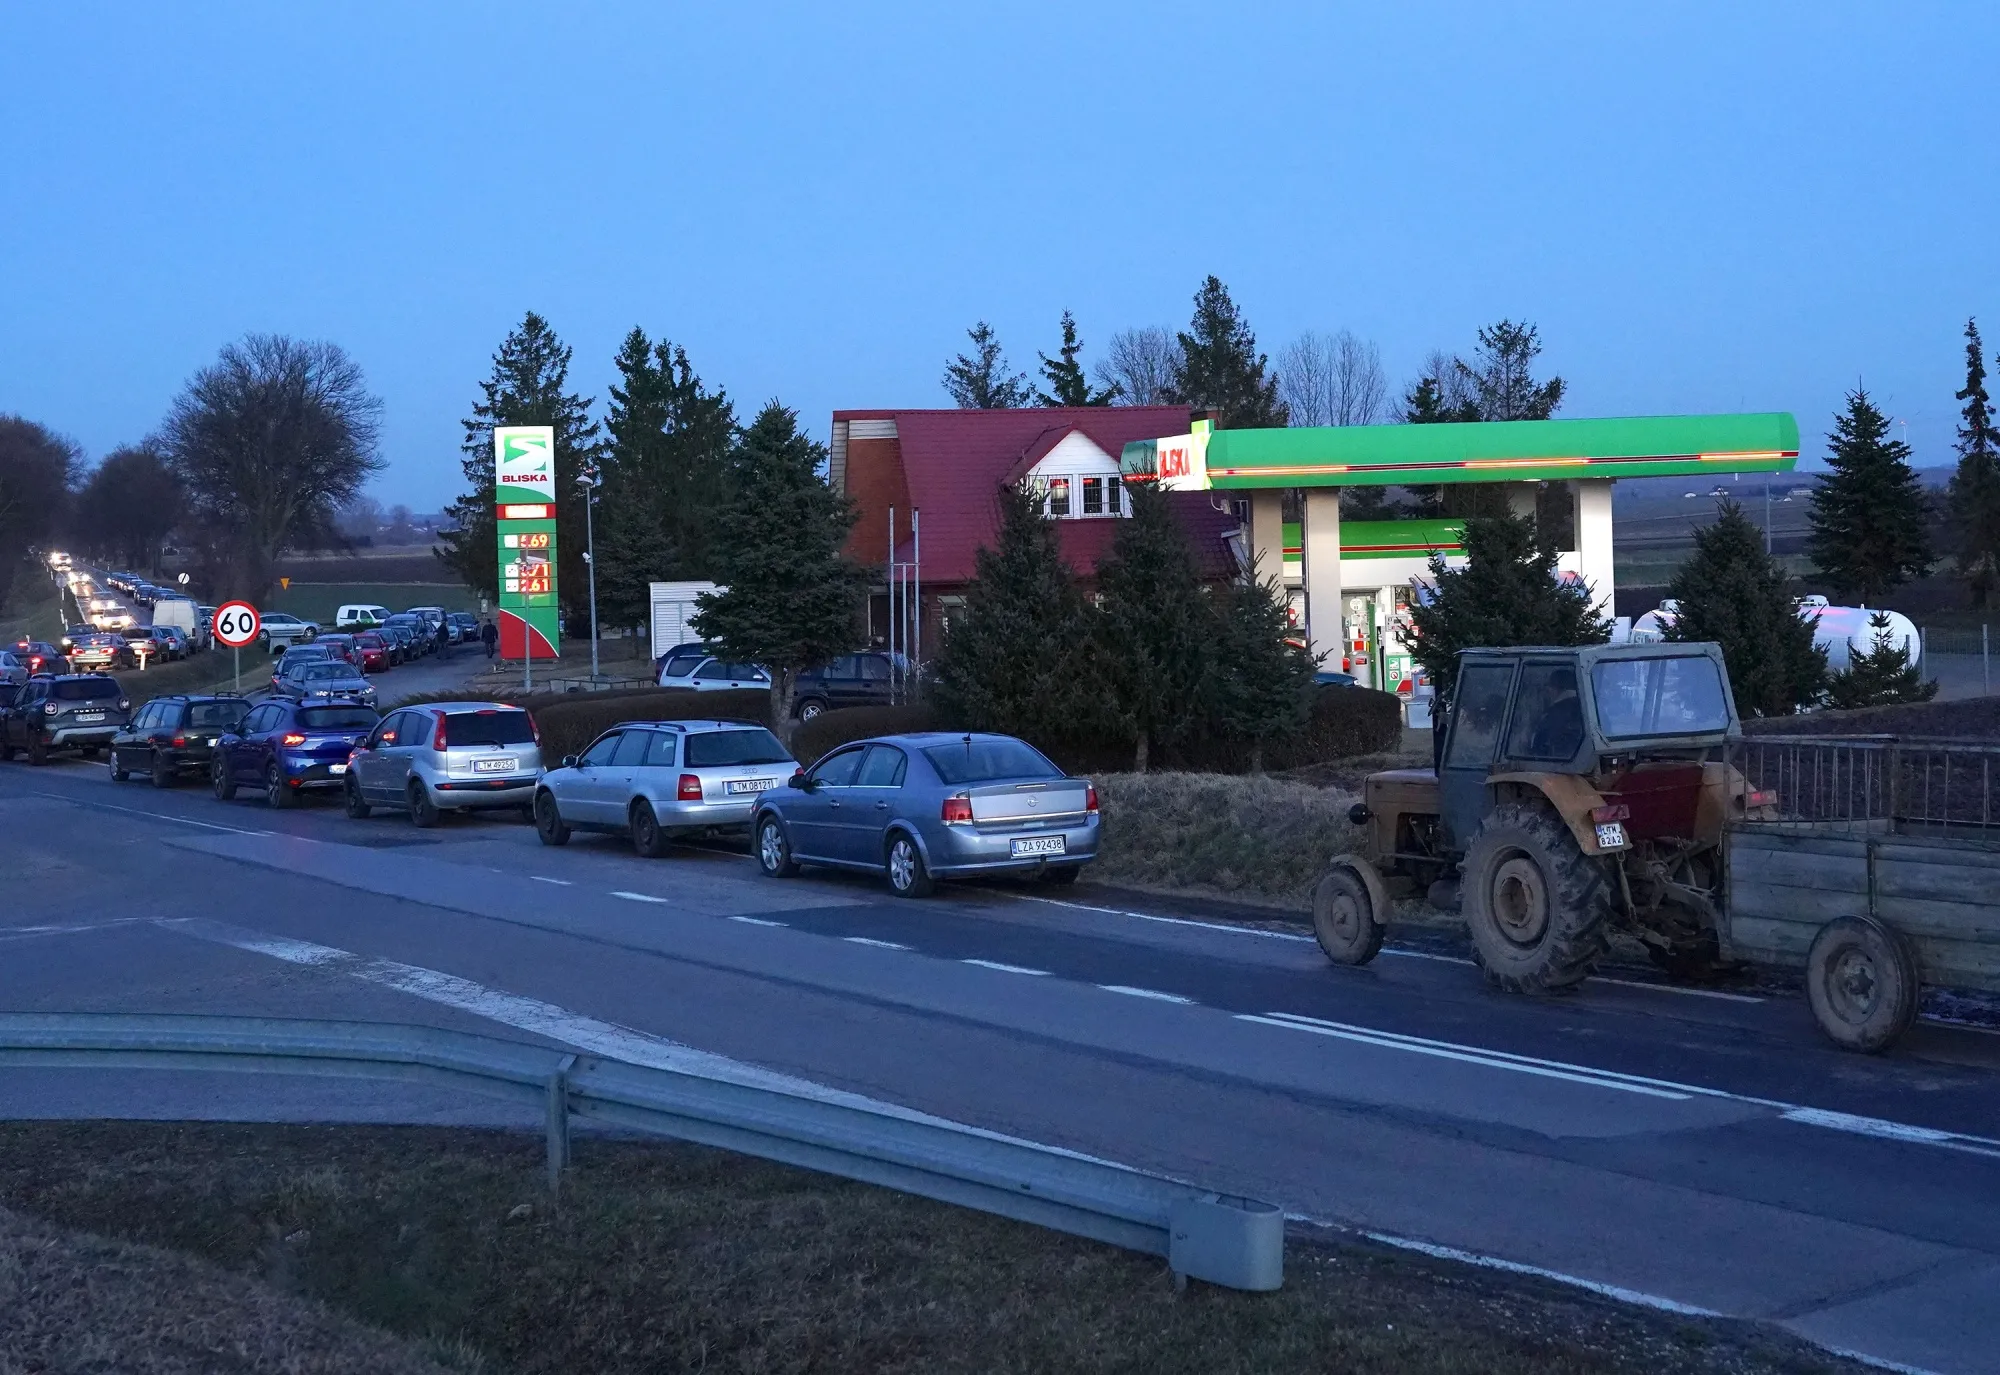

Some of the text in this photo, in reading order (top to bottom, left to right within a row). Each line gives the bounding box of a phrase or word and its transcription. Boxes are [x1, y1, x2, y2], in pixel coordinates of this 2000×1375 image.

[502, 474, 548, 482] BLISKA
[220, 612, 253, 635] 60
[478, 761, 492, 771] LTM
[732, 780, 772, 792] LTM 08121
[1017, 839, 1062, 853] LZA 92438
